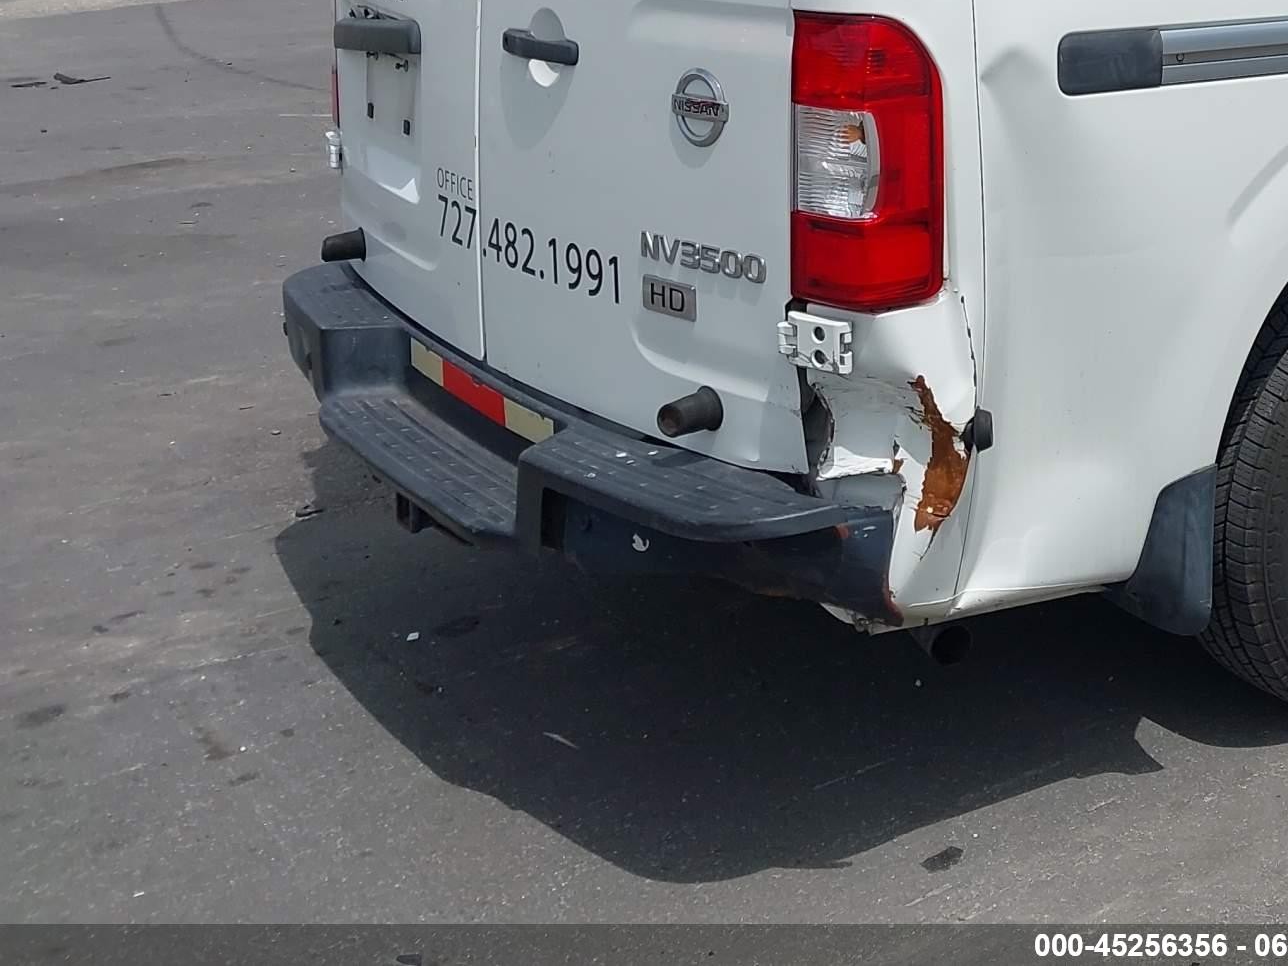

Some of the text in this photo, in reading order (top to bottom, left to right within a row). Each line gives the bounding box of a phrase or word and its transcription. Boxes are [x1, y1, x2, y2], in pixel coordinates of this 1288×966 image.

[672, 98, 721, 117] NISSAN
[437, 167, 473, 202] OFFICE
[438, 195, 620, 304] 727.482.1991
[640, 231, 767, 284] NV3500
[650, 283, 685, 312] HD
